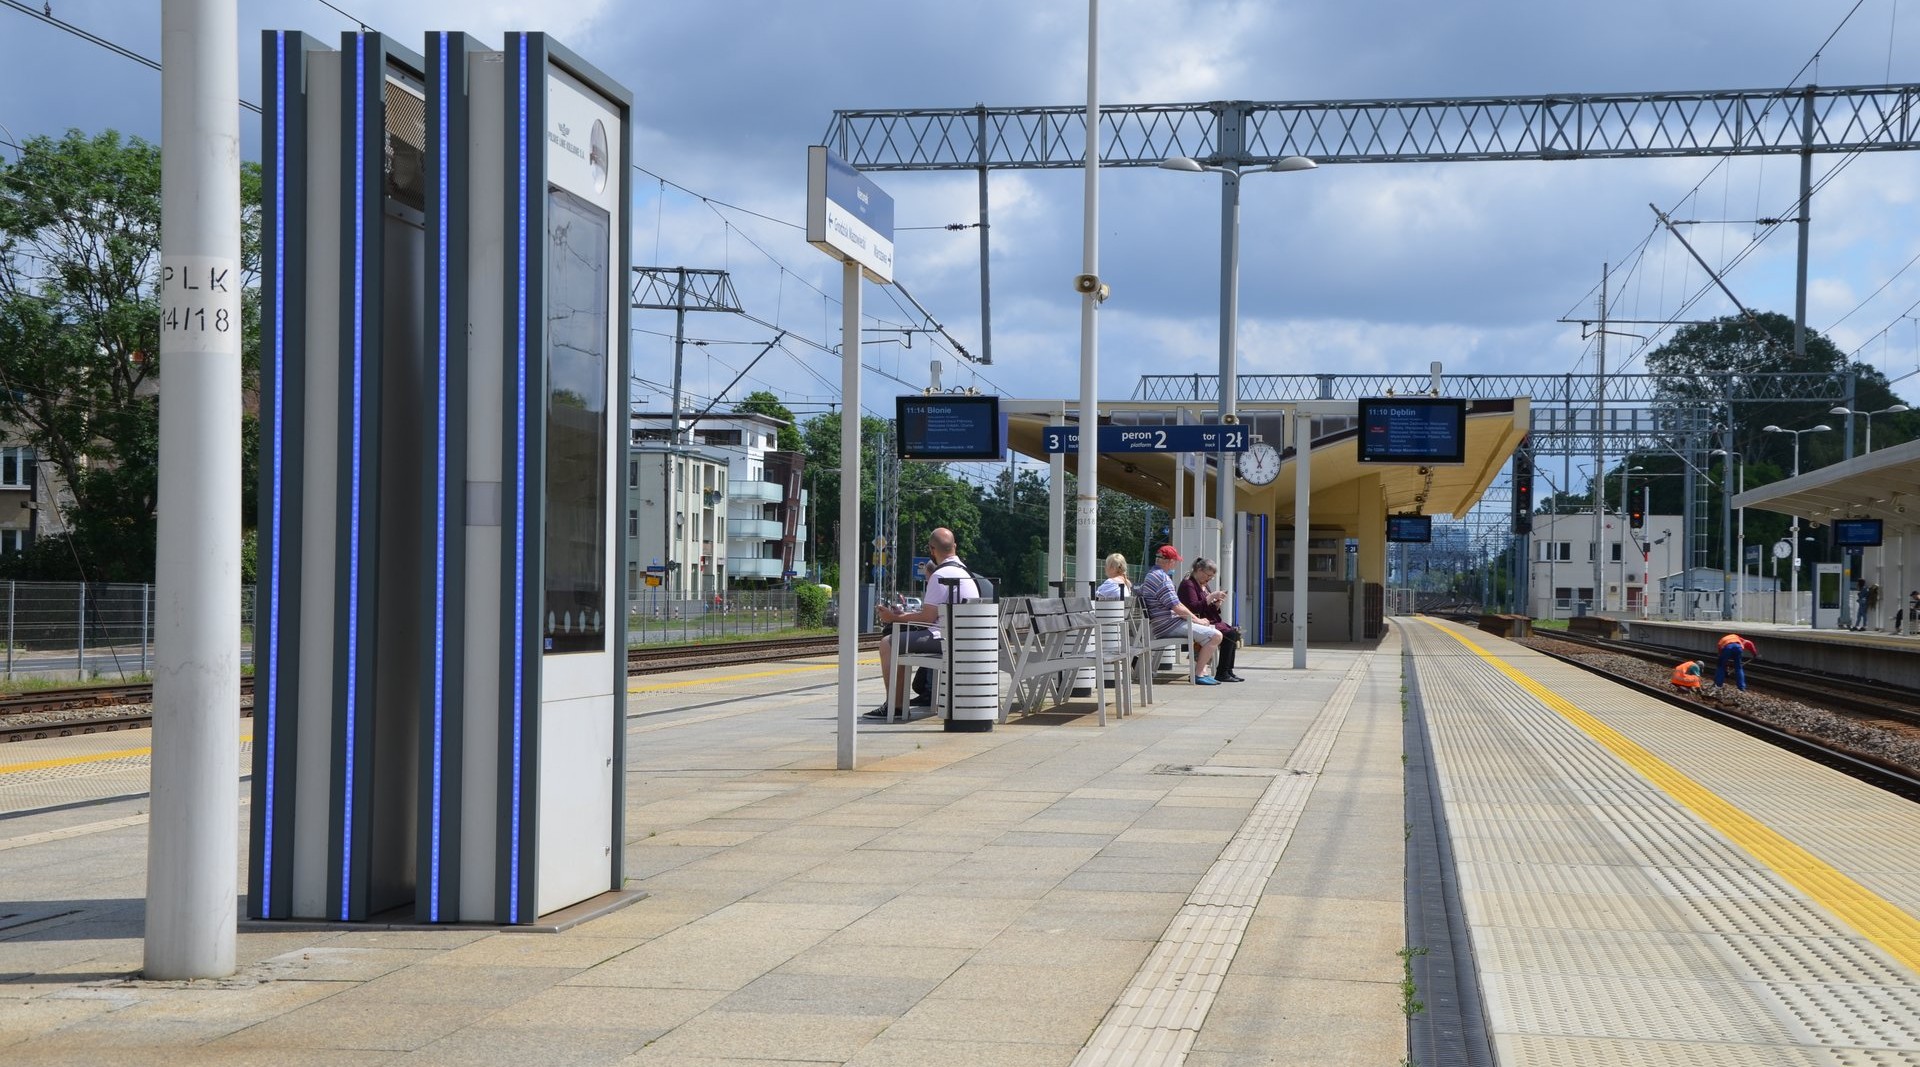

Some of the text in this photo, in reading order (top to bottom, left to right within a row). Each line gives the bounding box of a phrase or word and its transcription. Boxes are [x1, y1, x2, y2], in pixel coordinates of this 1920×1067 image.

[162, 265, 229, 292] PLK
[162, 307, 229, 332] 14/18
[1049, 434, 1060, 449] 3
[1121, 430, 1167, 449] peron 2
[1225, 431, 1243, 448] 2ł
